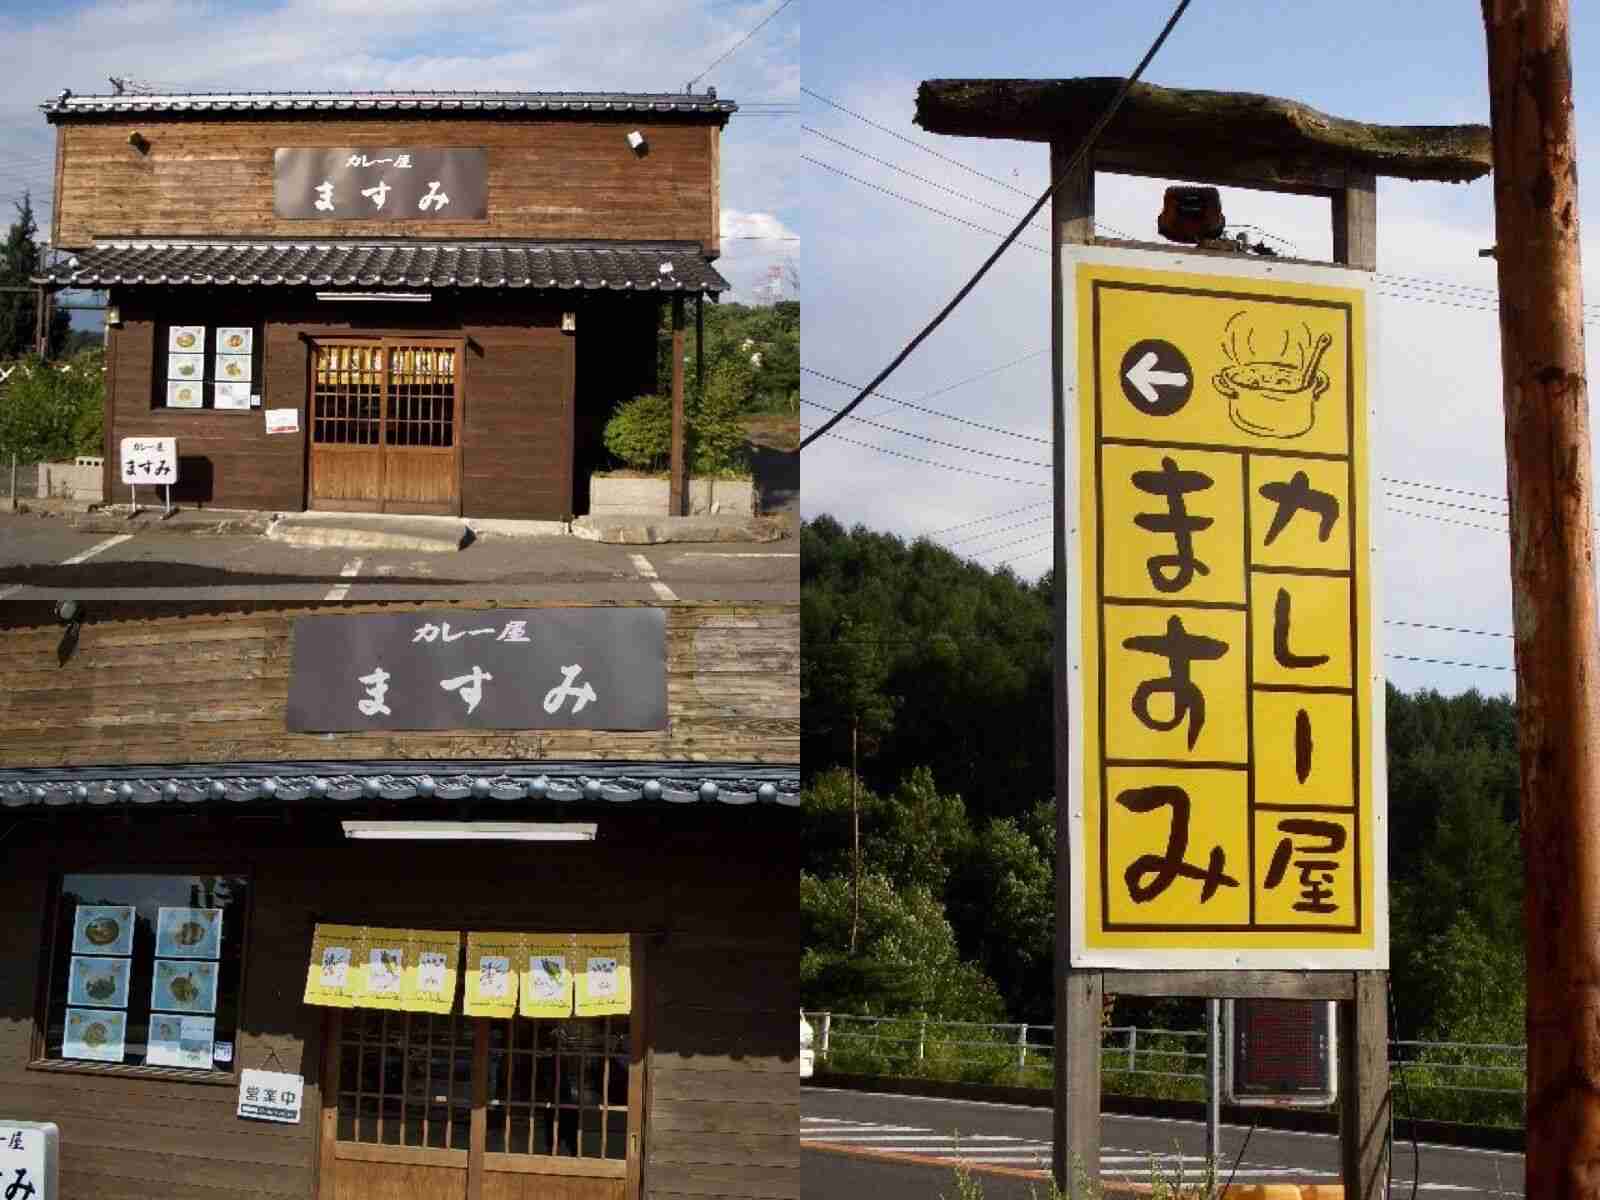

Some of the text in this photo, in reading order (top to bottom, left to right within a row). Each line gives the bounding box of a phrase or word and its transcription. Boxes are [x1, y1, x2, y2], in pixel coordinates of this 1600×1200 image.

[345, 153, 412, 168] カレー屋
[314, 180, 450, 211] ますみ
[125, 460, 171, 476] ますみ
[411, 619, 532, 643] カレー屋
[357, 663, 598, 716] ますみ
[1116, 456, 1240, 905] ますみ
[1258, 470, 1347, 914] カレー屋
[0, 1168, 36, 1200] み
